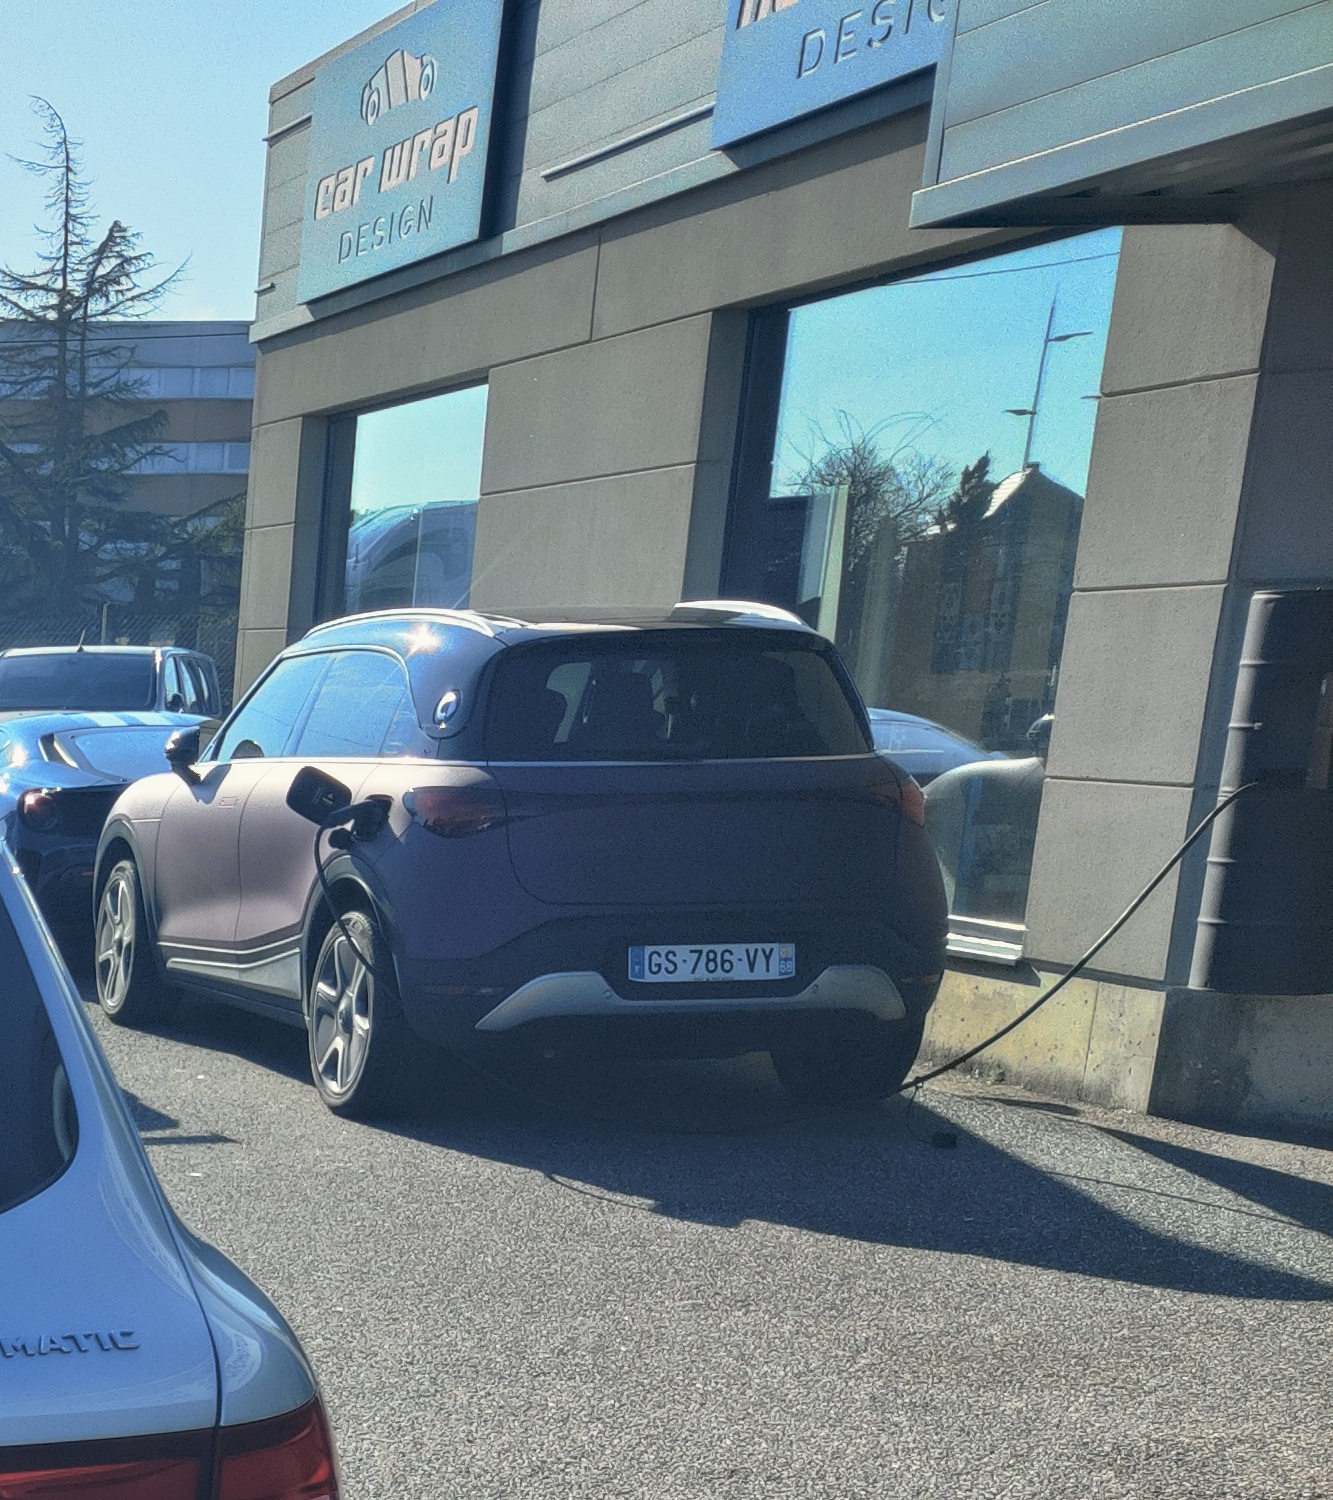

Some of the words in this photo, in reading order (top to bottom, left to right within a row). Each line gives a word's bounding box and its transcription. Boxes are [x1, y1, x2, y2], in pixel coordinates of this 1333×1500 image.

[314, 154, 375, 220] car
[378, 105, 479, 194] wrap
[338, 195, 433, 264] DESIGN
[648, 947, 775, 975] GS-786-VY
